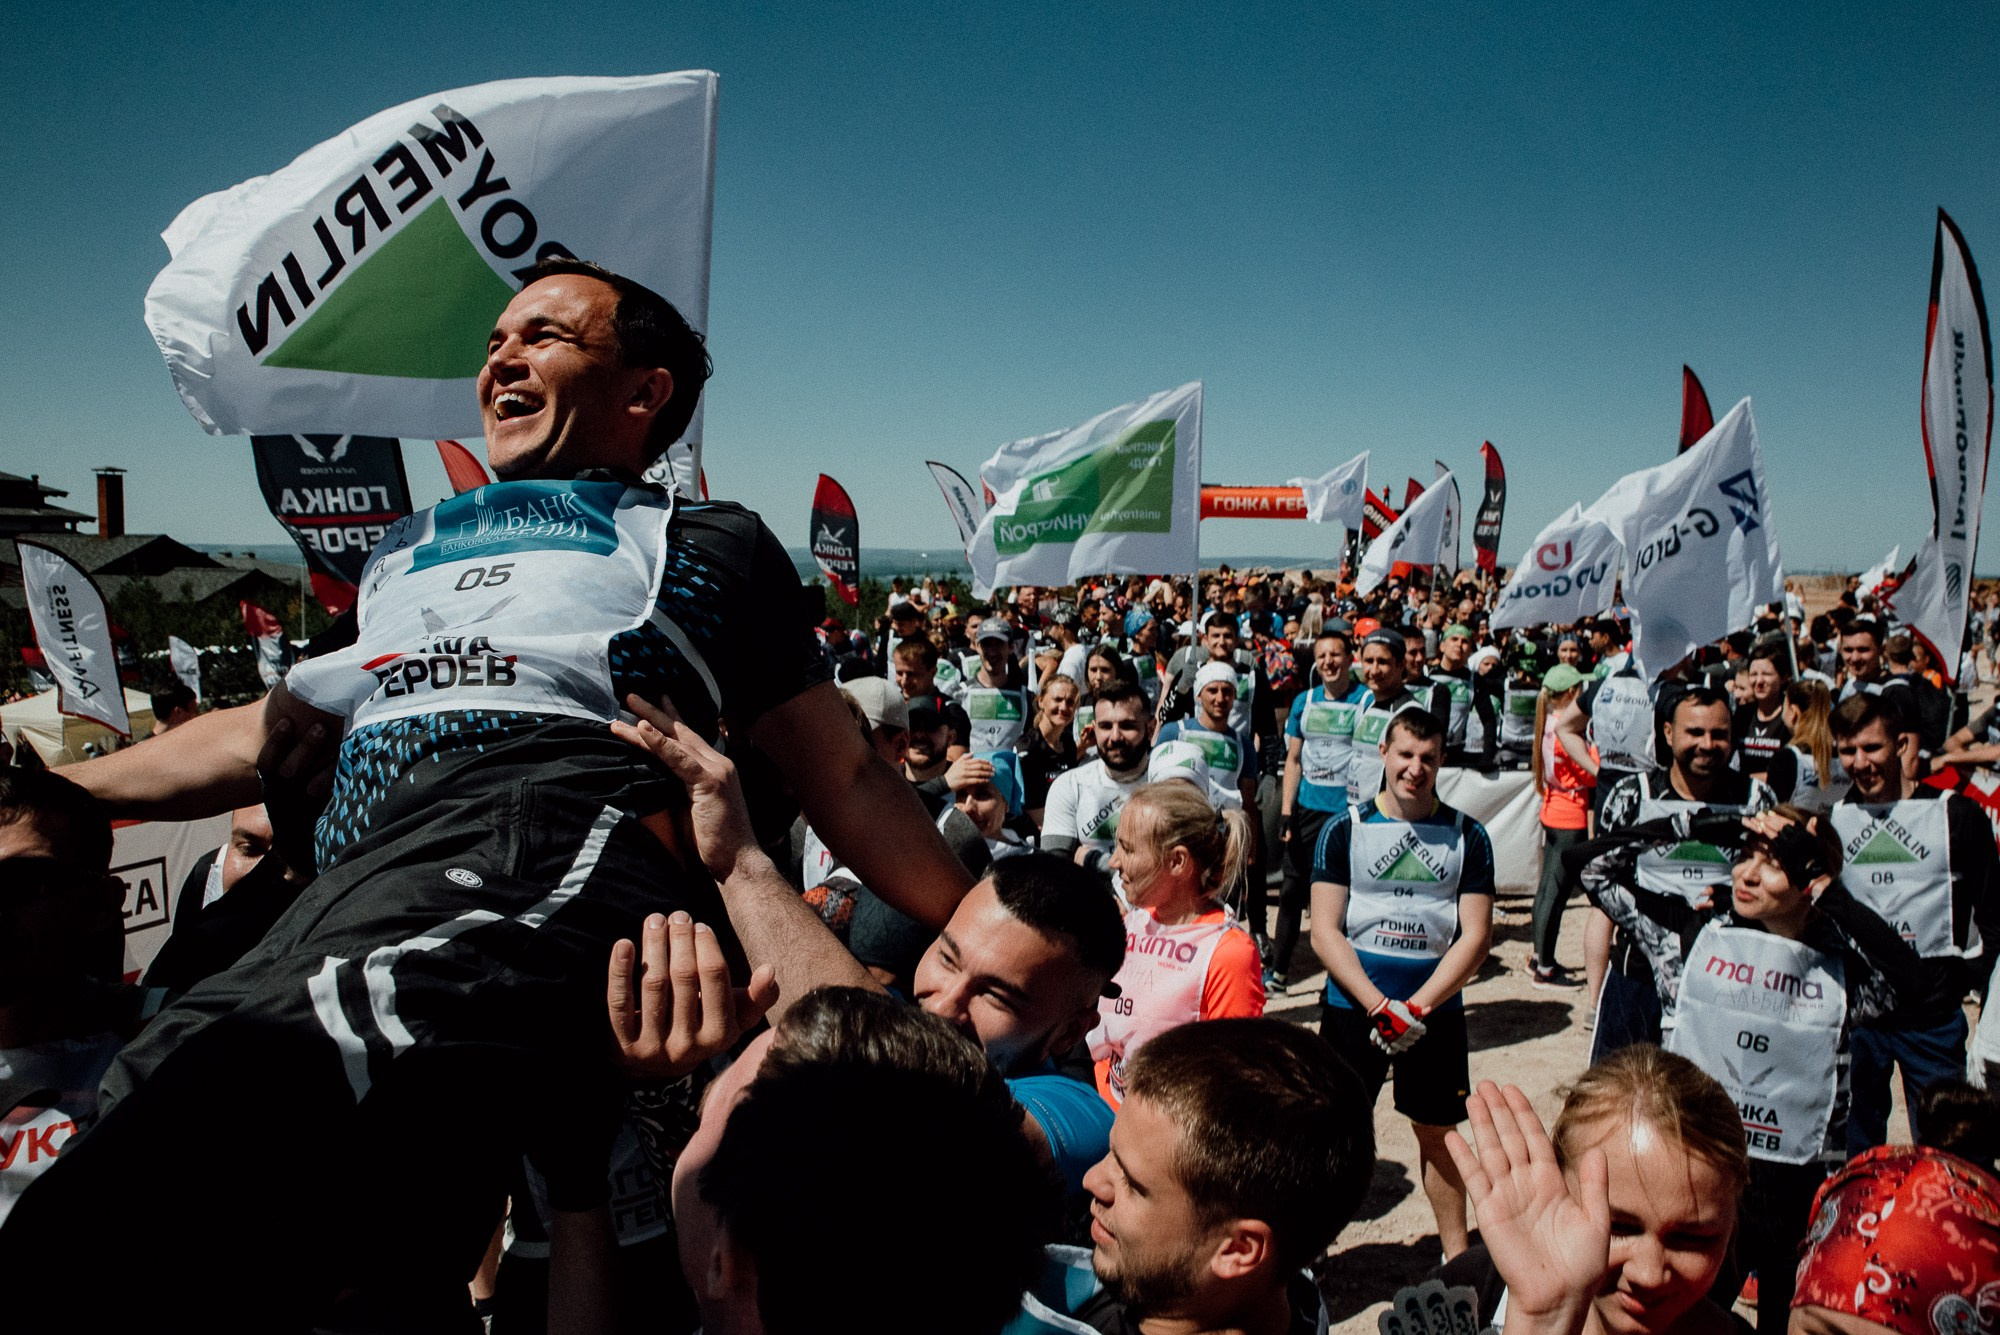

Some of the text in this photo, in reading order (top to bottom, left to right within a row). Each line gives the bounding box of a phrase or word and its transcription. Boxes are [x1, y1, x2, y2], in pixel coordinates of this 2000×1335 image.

[503, 492, 583, 532] БАНК
[1213, 496, 1307, 512] ГОНКА ГЕР
[453, 562, 516, 592] 05
[1081, 797, 1118, 838] LEROY
[1844, 818, 1879, 864] LEROY
[1367, 831, 1449, 881] LEROY MERLIN
[1682, 867, 1704, 880] 05
[1871, 871, 1895, 885] 08
[1393, 886, 1414, 898] 04
[1379, 919, 1427, 934] ГОНКА
[1125, 932, 1199, 964] axima
[1374, 935, 1428, 951] ГЕРОЕВ
[1705, 955, 1824, 1000] maxima
[1114, 997, 1134, 1017] 09
[1736, 1030, 1770, 1054] 06
[1738, 1101, 1780, 1127] НКА
